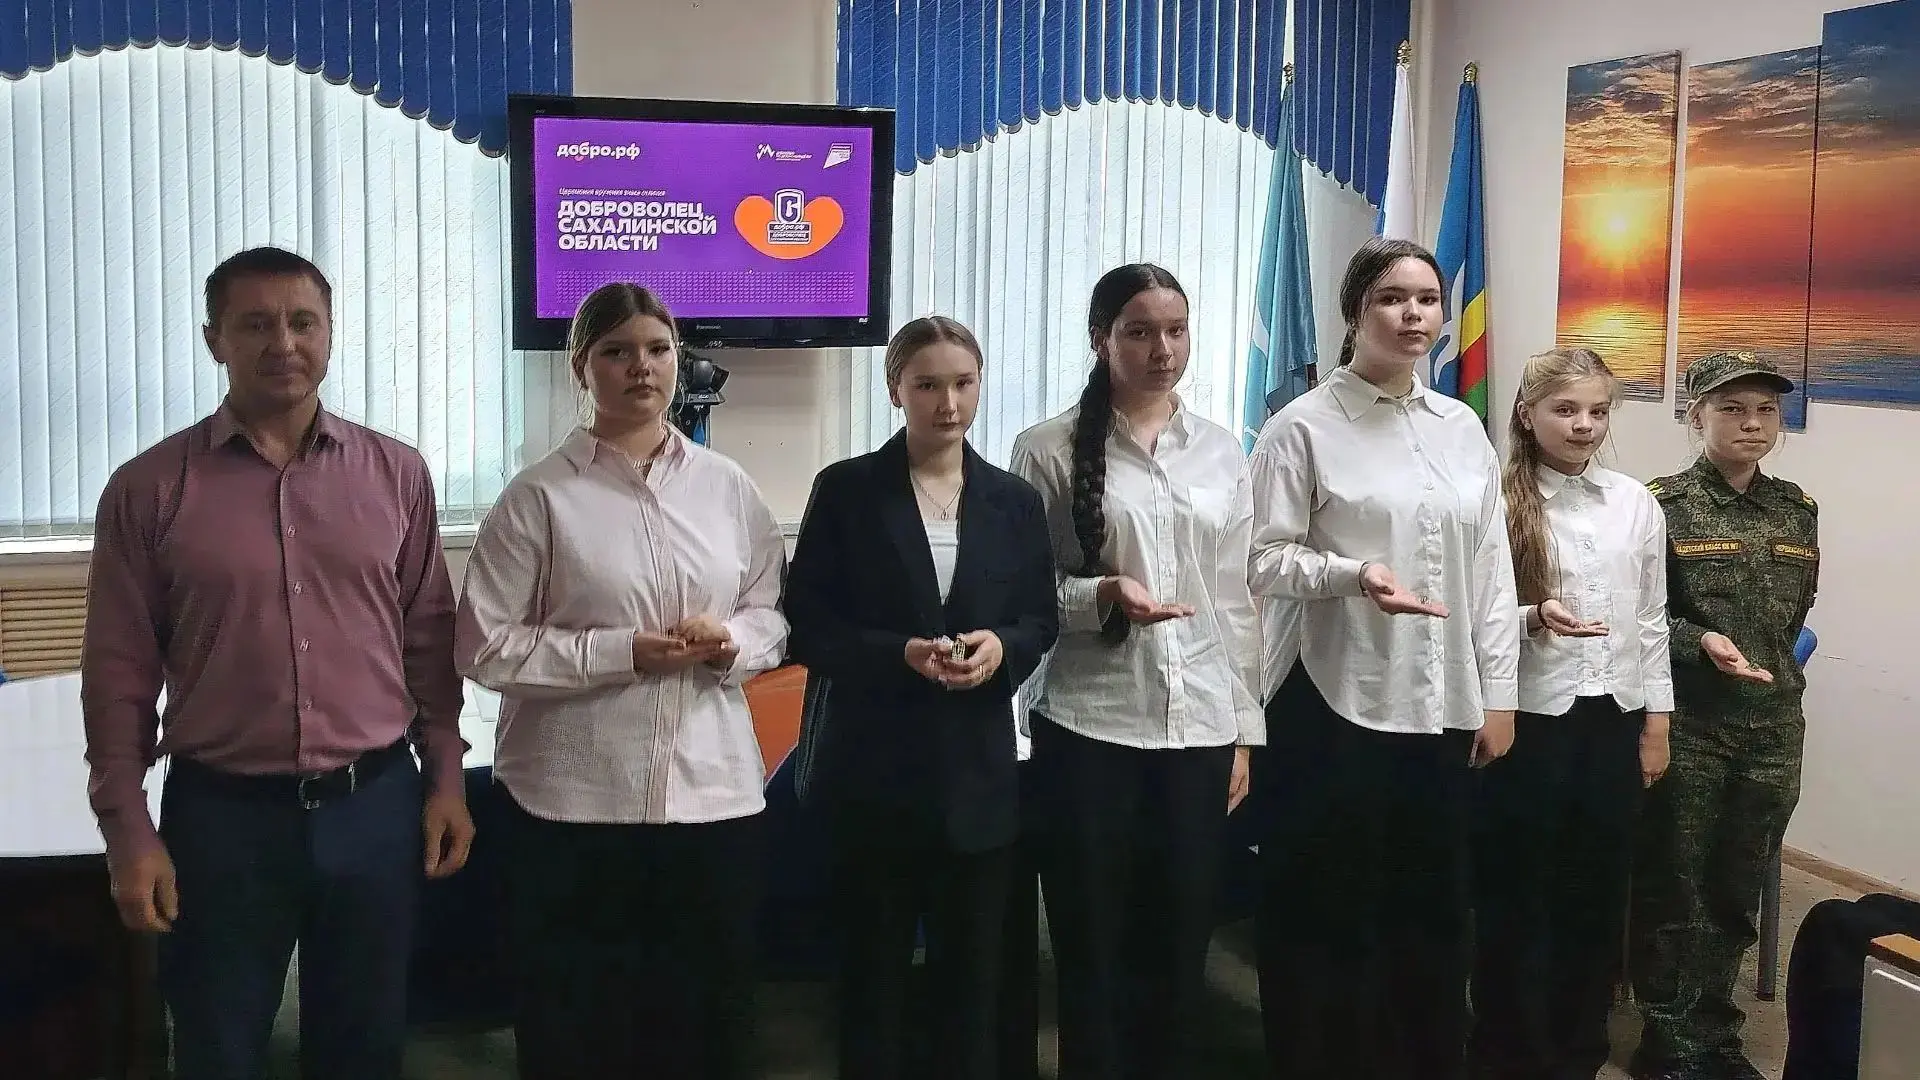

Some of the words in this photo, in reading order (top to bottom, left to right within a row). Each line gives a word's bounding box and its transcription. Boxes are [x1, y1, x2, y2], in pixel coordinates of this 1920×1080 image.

[557, 142, 640, 160] добро.рф
[558, 200, 704, 220] ДОБРОВОЛЕЦ
[558, 215, 717, 235] САХАЛИНСКОЙ
[558, 234, 658, 251] ОБЛАСТИ
